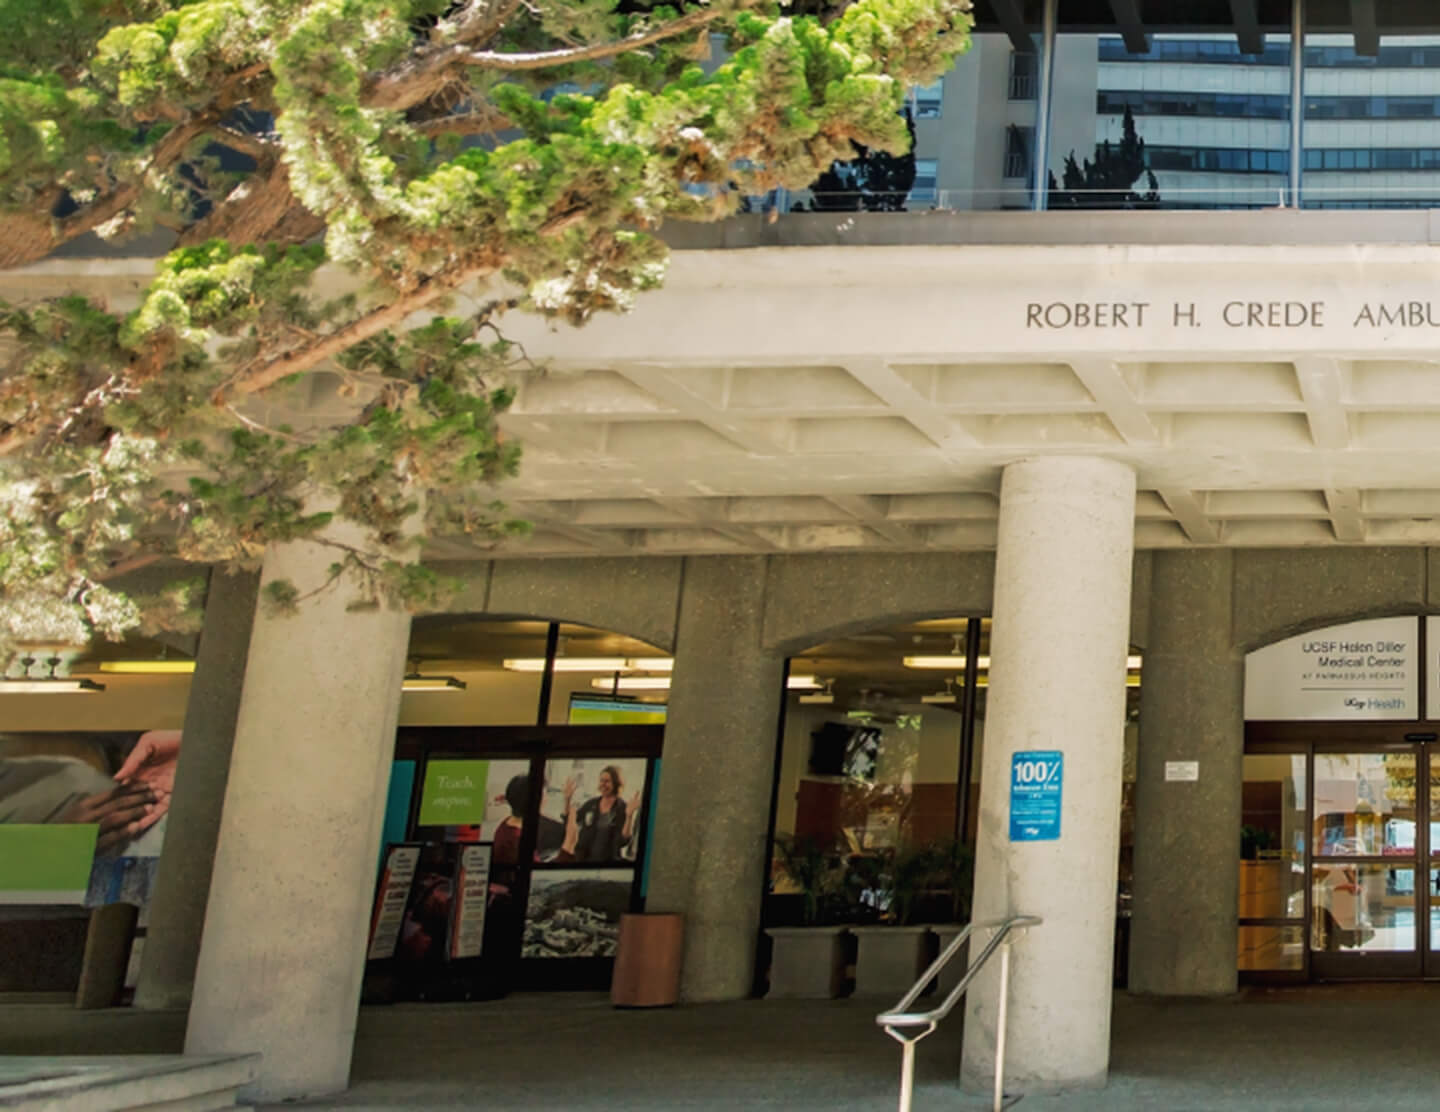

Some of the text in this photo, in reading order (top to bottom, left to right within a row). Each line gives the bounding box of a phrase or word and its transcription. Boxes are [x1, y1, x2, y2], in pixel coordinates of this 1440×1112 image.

[1025, 302, 1150, 329] ROBERT
[1173, 302, 1201, 328] H.
[1222, 301, 1325, 328] CREDE
[1303, 641, 1406, 653] UCSF Helen Diller
[1319, 656, 1406, 667] Medical Center
[1367, 698, 1406, 709] Health
[1014, 761, 1060, 782] 100%
